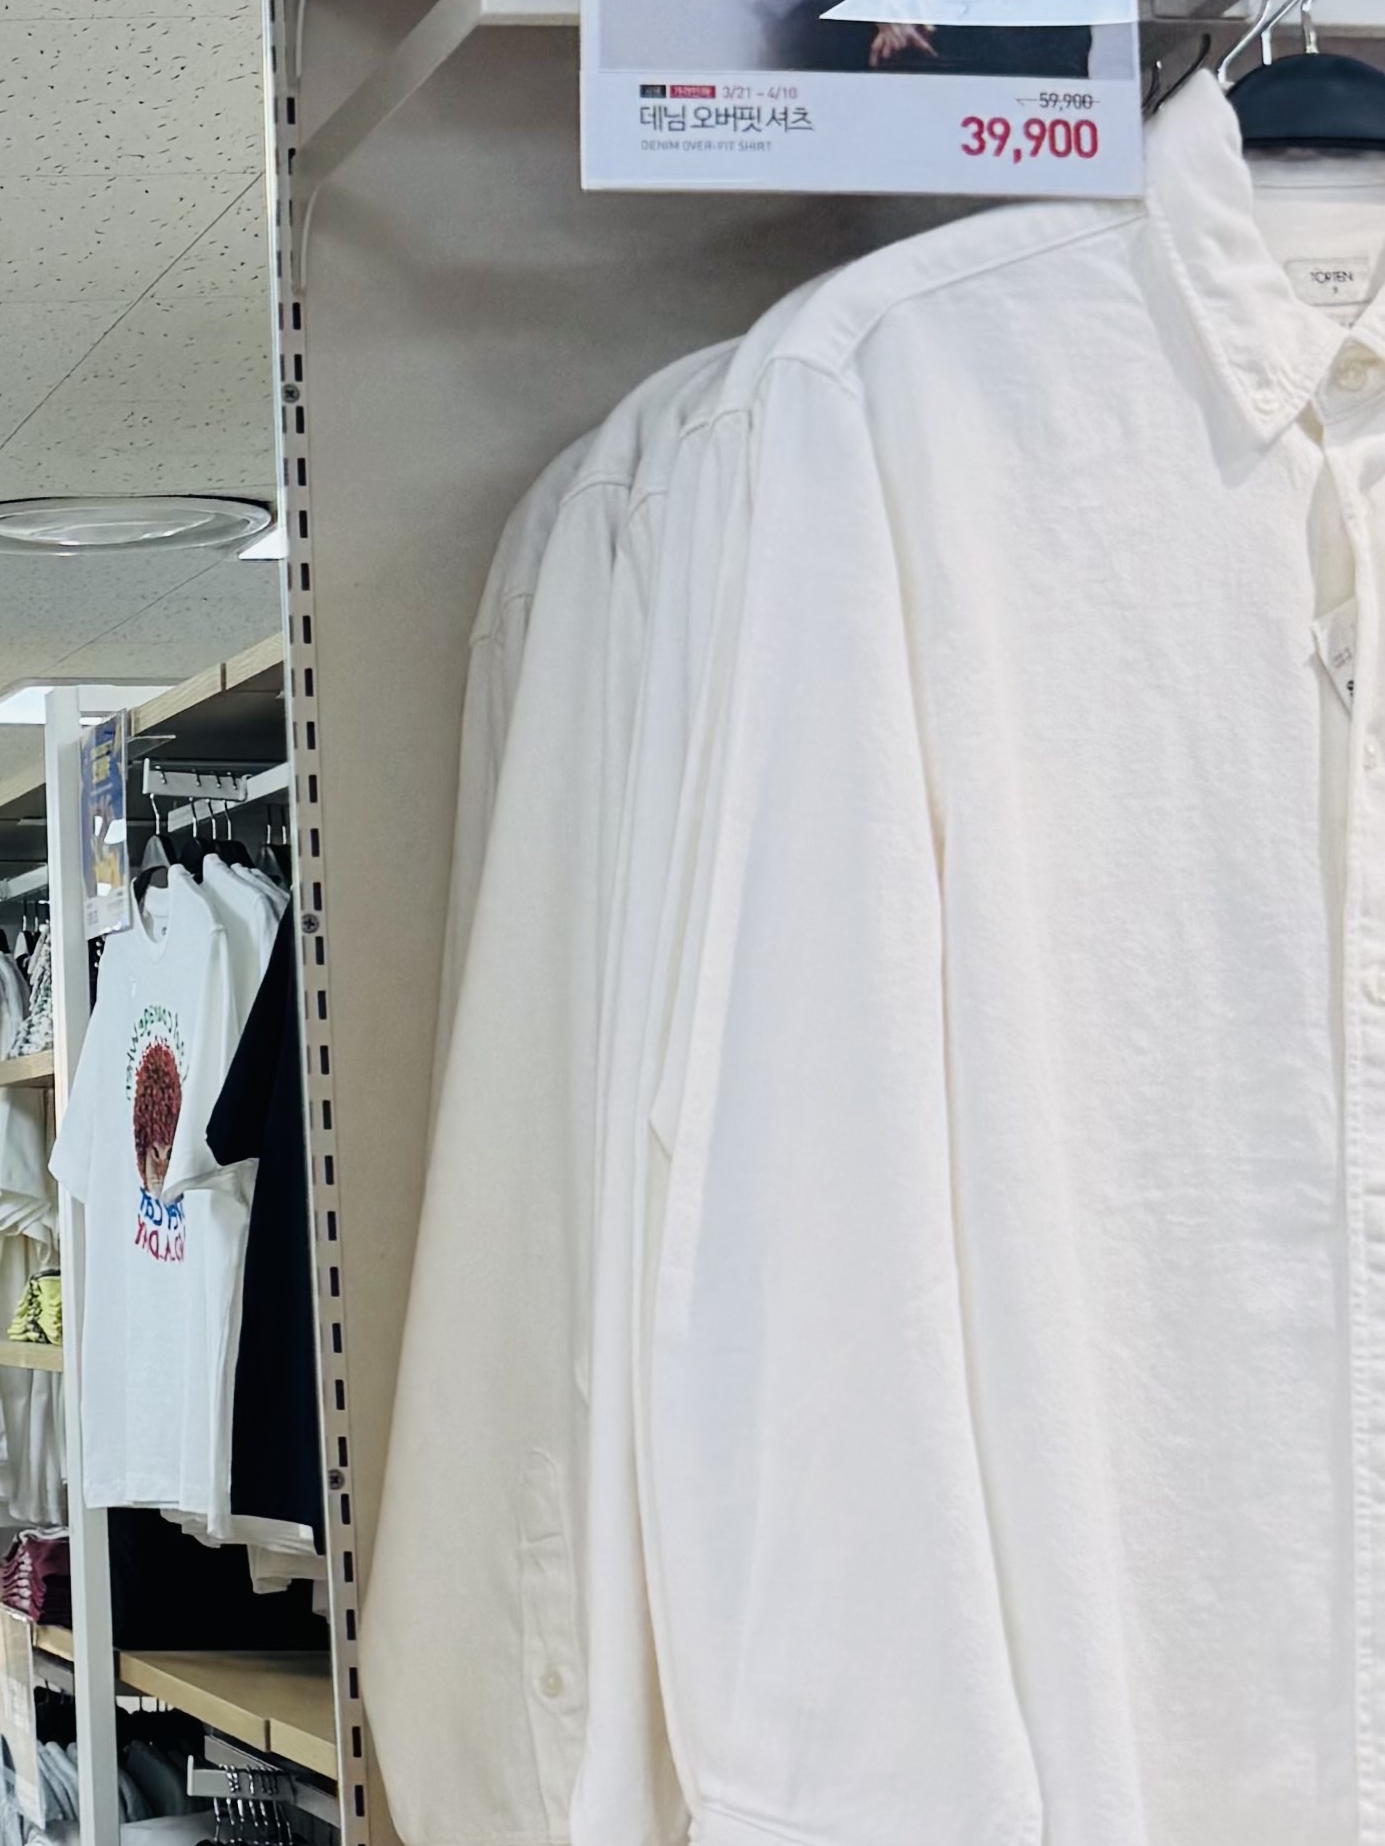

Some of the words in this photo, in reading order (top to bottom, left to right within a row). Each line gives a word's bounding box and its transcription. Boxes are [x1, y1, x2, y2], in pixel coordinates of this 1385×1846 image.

[722, 86, 751, 99] 3/21
[767, 86, 798, 99] 4/10
[1039, 92, 1093, 111] 59,900
[639, 105, 686, 132] 데님
[690, 105, 762, 132] 오버핏
[766, 106, 814, 132] 셔츠
[641, 140, 679, 150] DENIM
[738, 141, 772, 151] SHIRT
[961, 116, 1099, 165] 39,900
